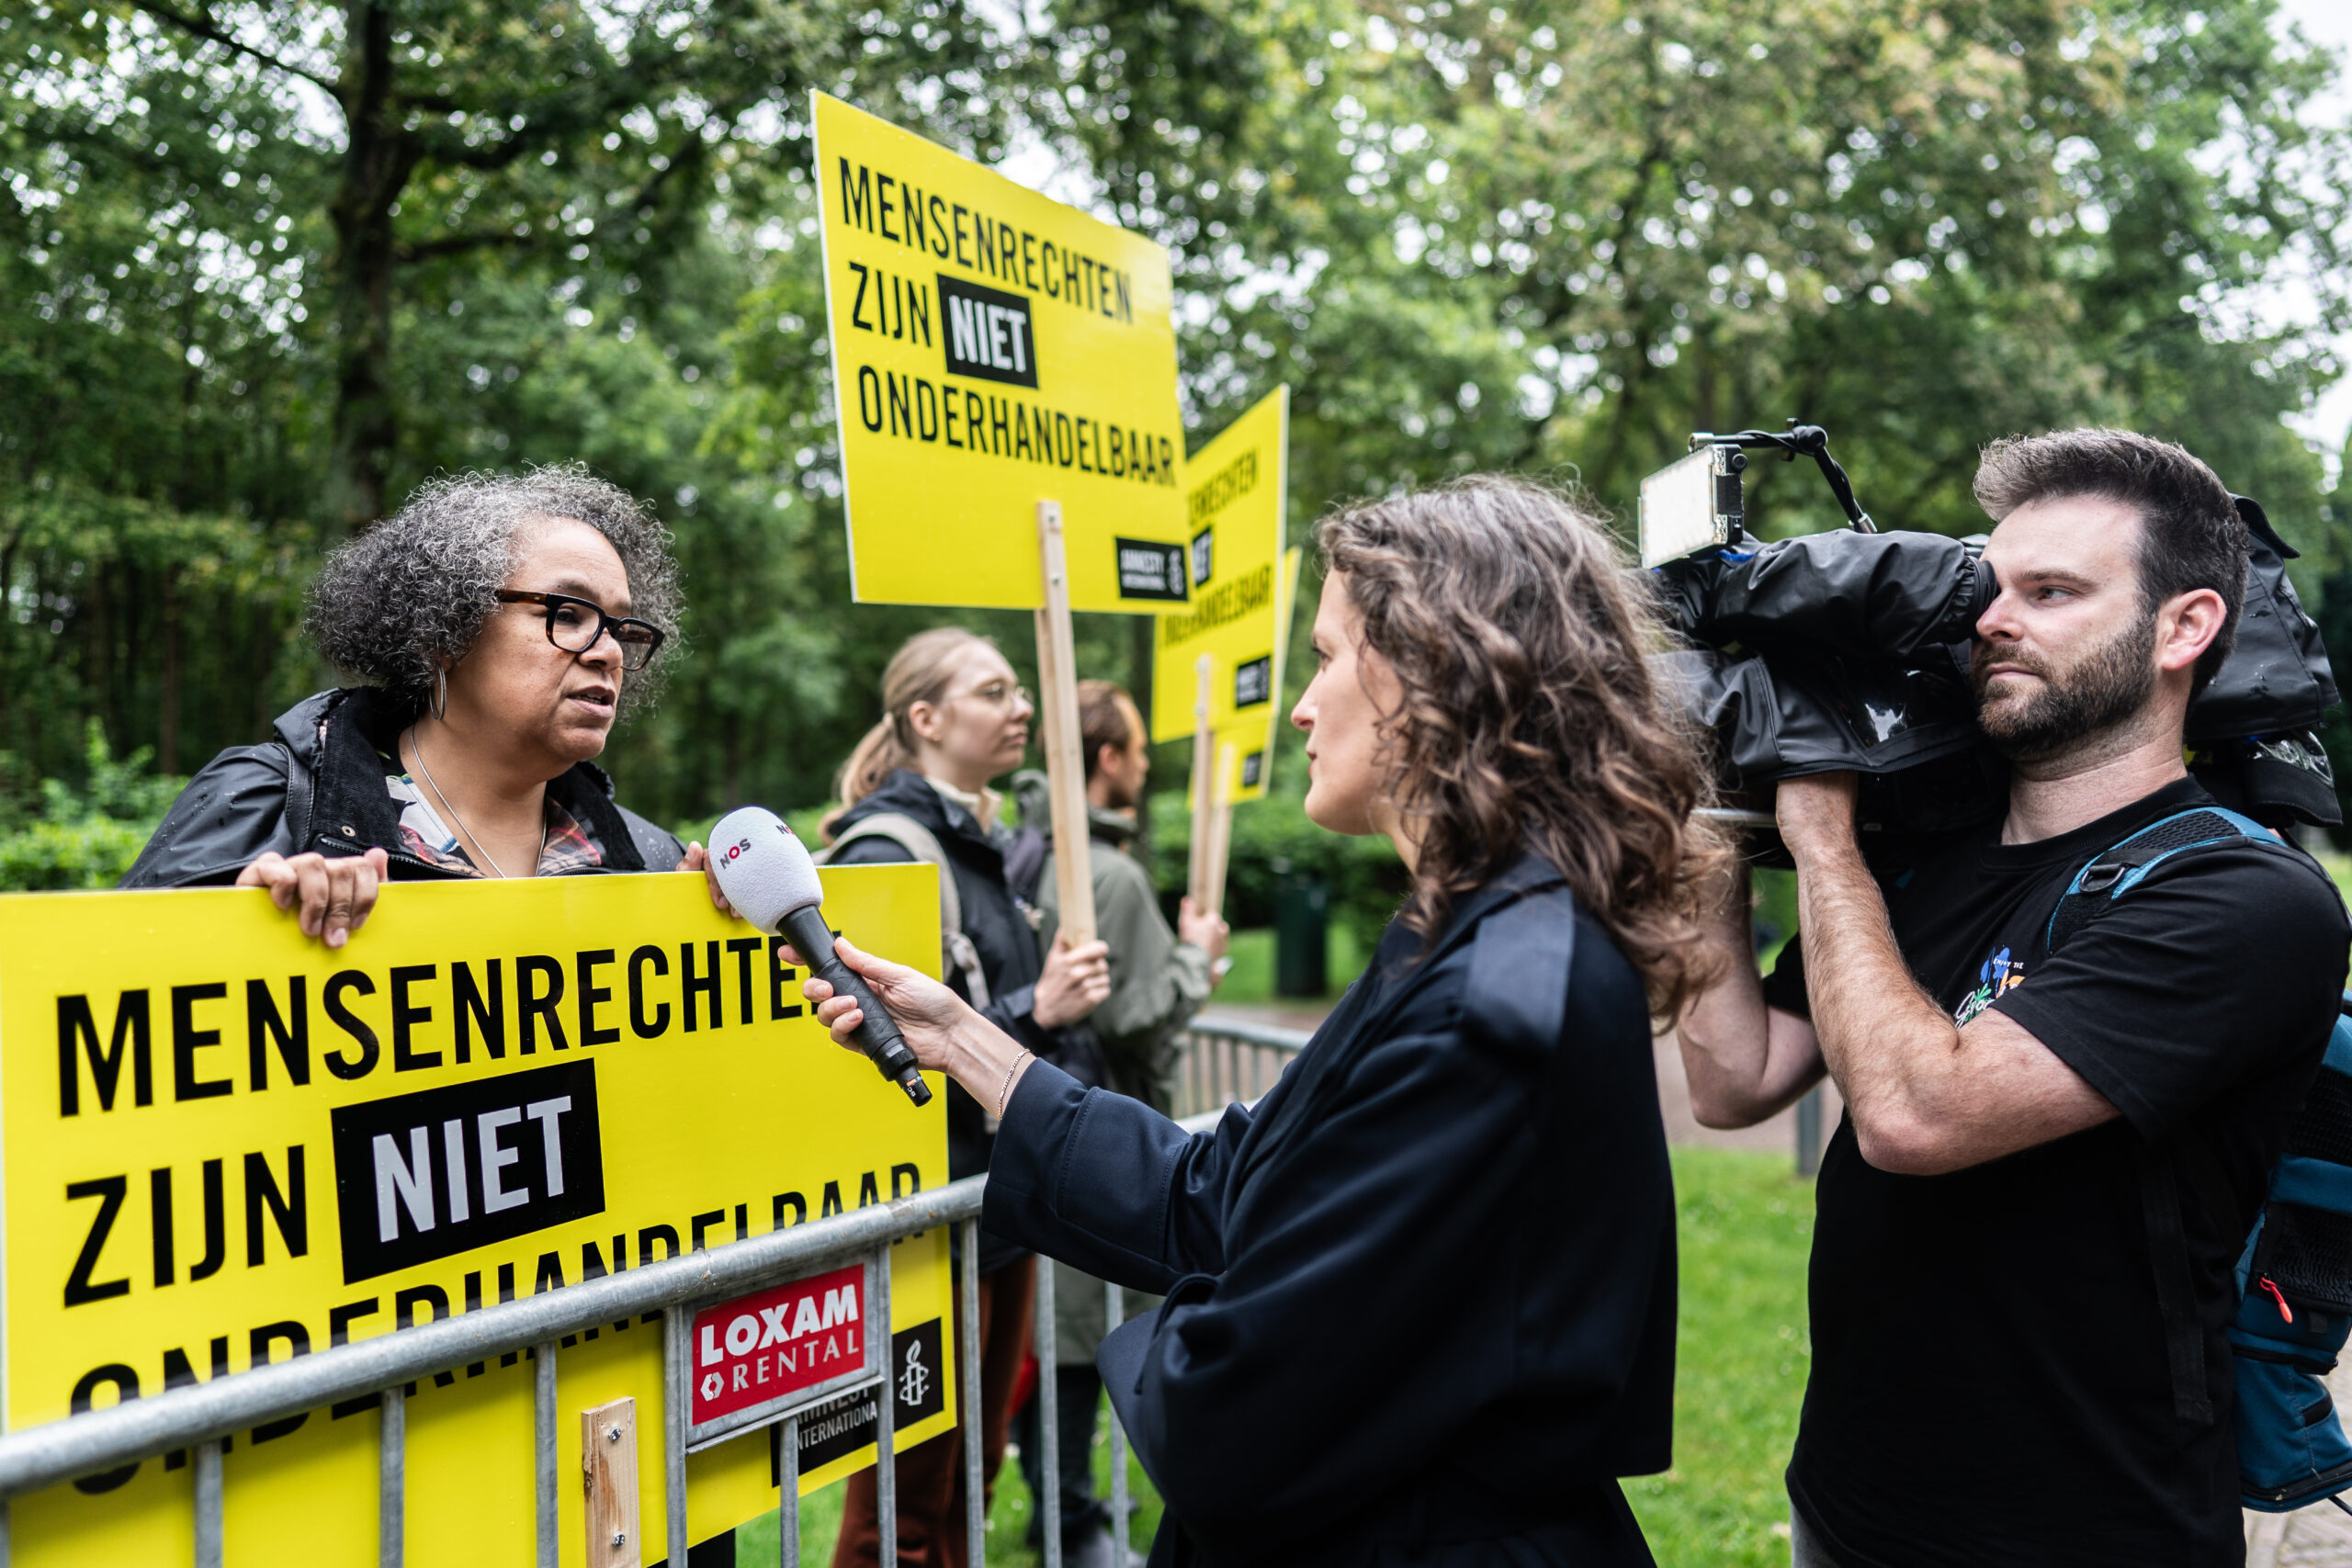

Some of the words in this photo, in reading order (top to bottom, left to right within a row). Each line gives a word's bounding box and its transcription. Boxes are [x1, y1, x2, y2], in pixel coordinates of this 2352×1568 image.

[839, 156, 1133, 324] MENSENRECHTEN
[849, 261, 932, 347] ZIJN
[948, 294, 1026, 372] NIET
[858, 365, 1176, 488] ONDERHANDELBAAR
[719, 838, 752, 870] NOS
[1993, 958, 2011, 967] ENJOY
[56, 931, 842, 1119] MENSENRECHTE
[63, 1145, 308, 1309] ZIJN
[372, 1095, 572, 1244] NIET
[701, 1284, 859, 1368] LOXAM
[732, 1329, 859, 1393] RENTAL
[797, 1401, 877, 1450] NTERNATIONA
